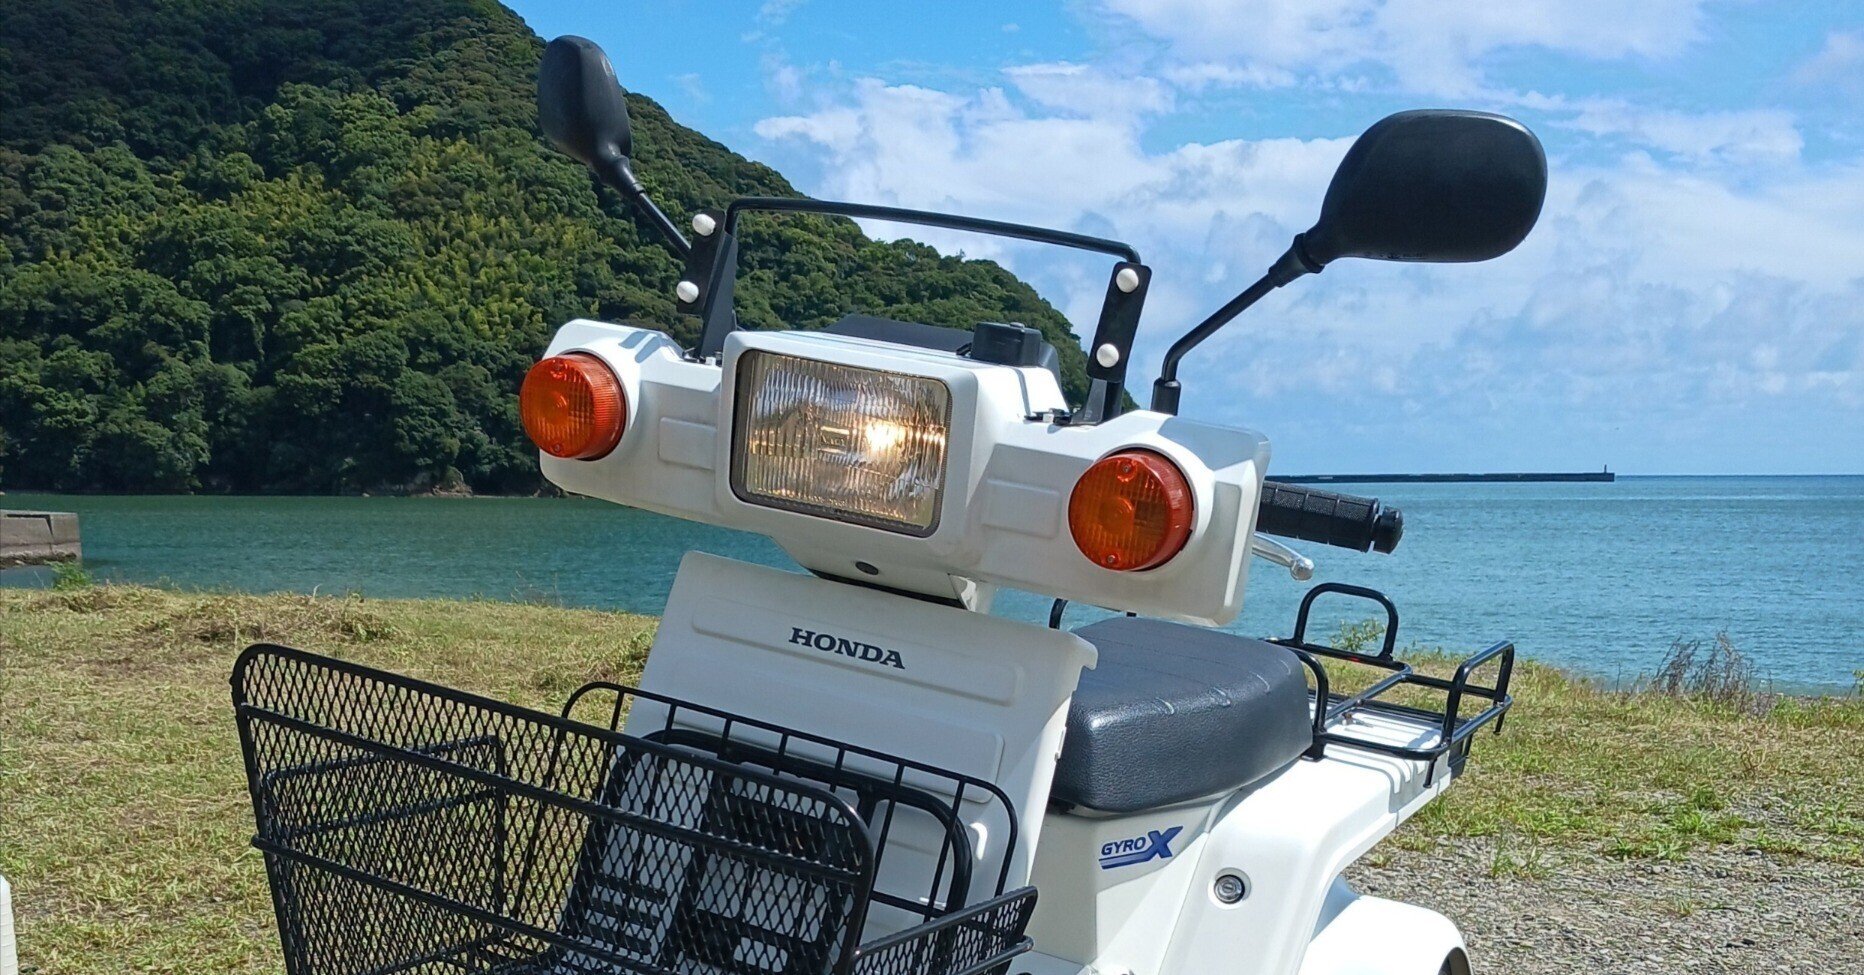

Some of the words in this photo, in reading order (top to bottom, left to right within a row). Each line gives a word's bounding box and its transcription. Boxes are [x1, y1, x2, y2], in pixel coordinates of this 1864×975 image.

[788, 626, 906, 670] HONDA
[1100, 836, 1147, 856] GYRO
[1147, 825, 1184, 859] X
